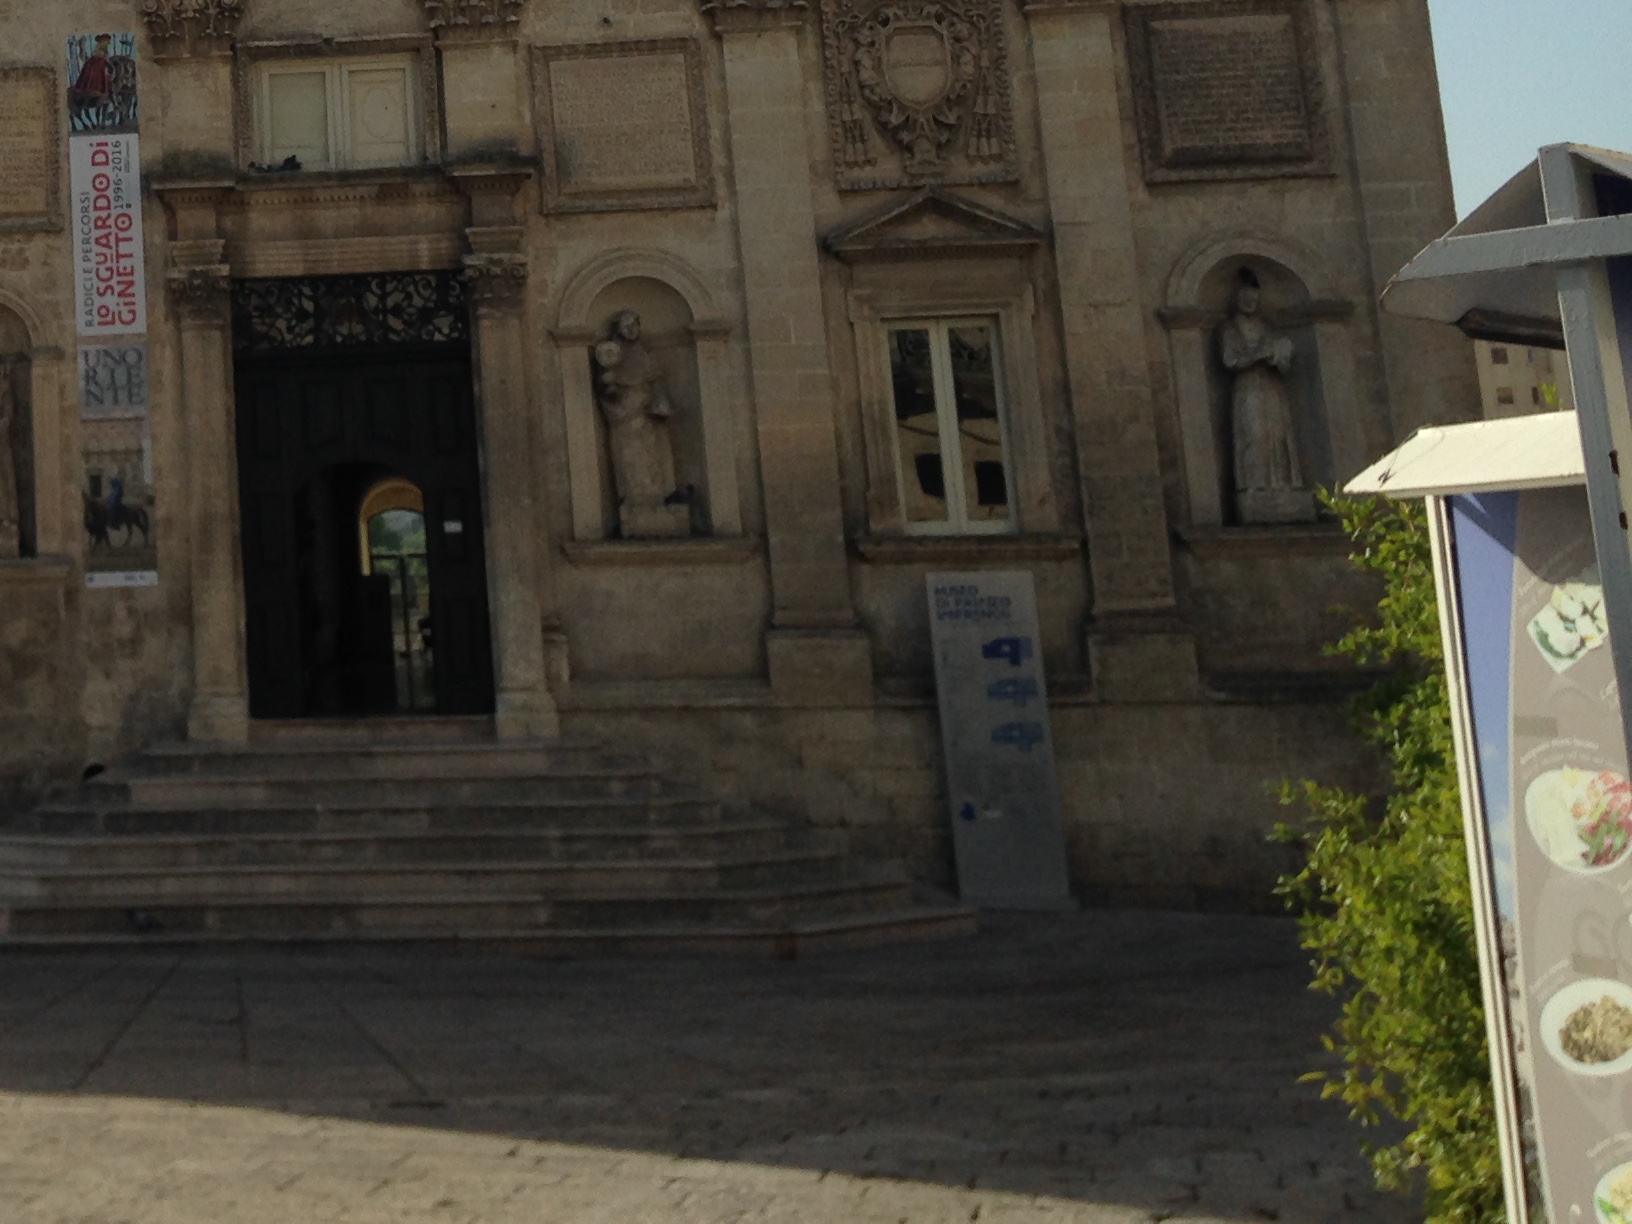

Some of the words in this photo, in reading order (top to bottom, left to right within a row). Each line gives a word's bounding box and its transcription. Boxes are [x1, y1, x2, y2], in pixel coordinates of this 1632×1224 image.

[111, 140, 124, 210] 1996-2016
[82, 191, 93, 262] PERCORSI
[84, 277, 95, 327] RADICI
